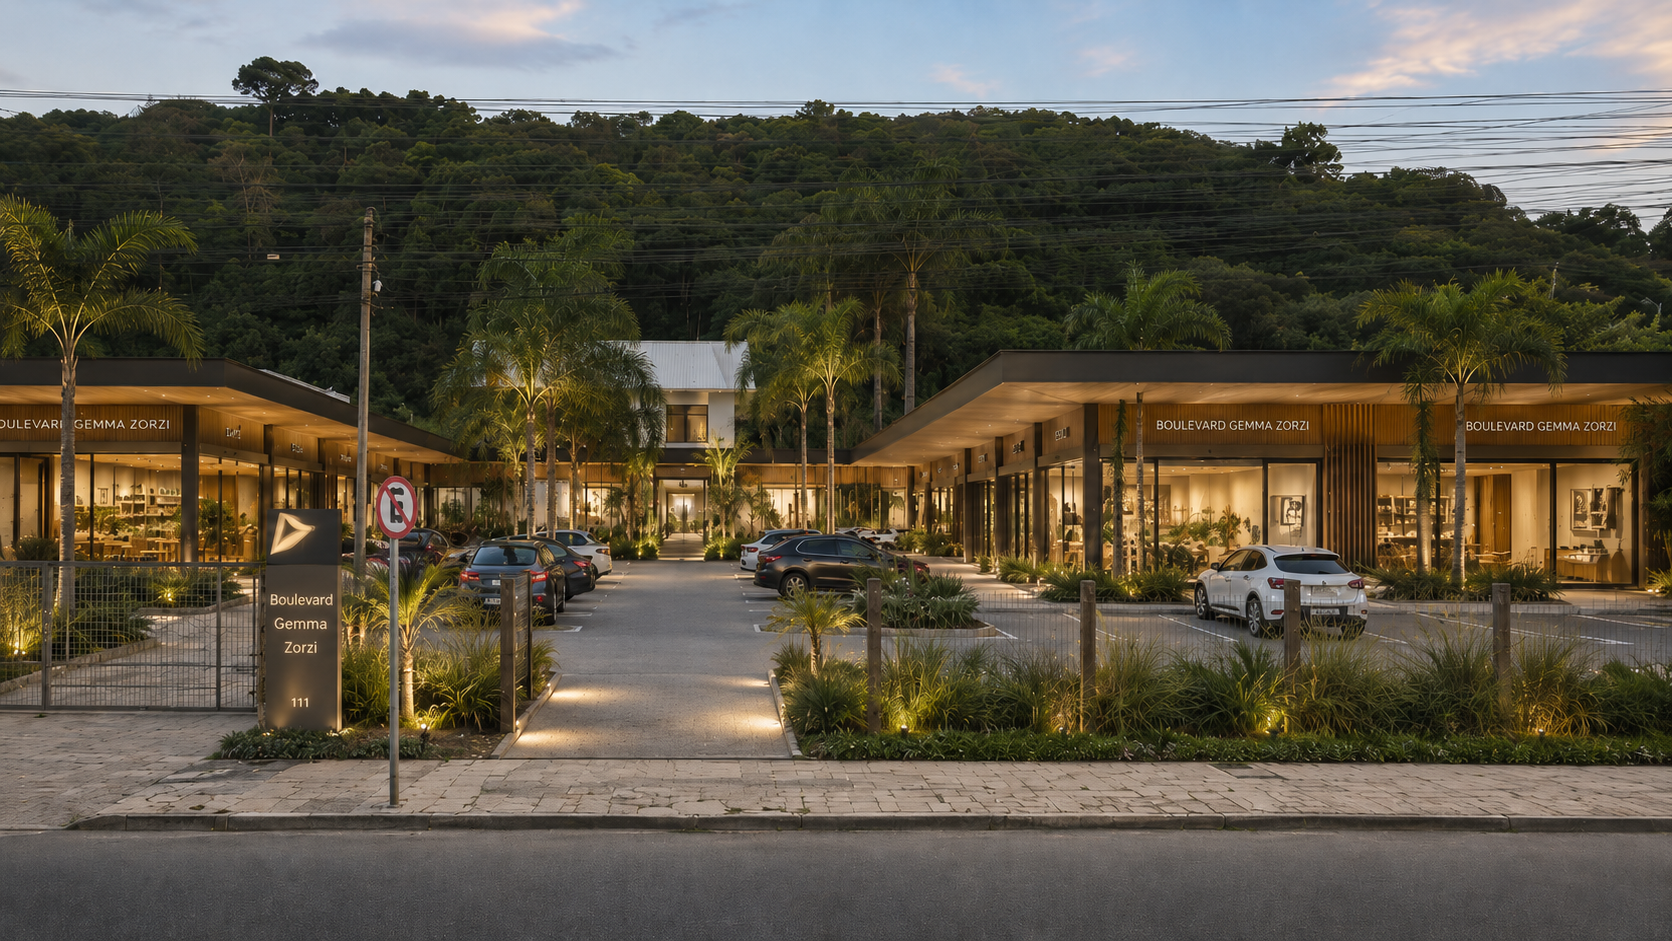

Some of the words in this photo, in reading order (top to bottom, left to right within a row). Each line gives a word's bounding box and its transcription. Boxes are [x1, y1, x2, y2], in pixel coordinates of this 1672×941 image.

[0, 419, 62, 430] OULEVAR
[74, 419, 125, 430] GEMMA
[130, 419, 170, 430] ZORZI
[1156, 420, 1226, 431] BOULEVARD
[1229, 420, 1273, 431] GEMMA
[1276, 420, 1310, 431] ZORZI
[1466, 421, 1535, 432] BOULEVARD
[1537, 421, 1580, 432] GEMMA
[1583, 421, 1617, 432] ZORZI
[270, 593, 333, 606] Boulevard
[274, 617, 327, 630] Gemma
[284, 641, 317, 654] Zorzi
[291, 697, 309, 708] 111
